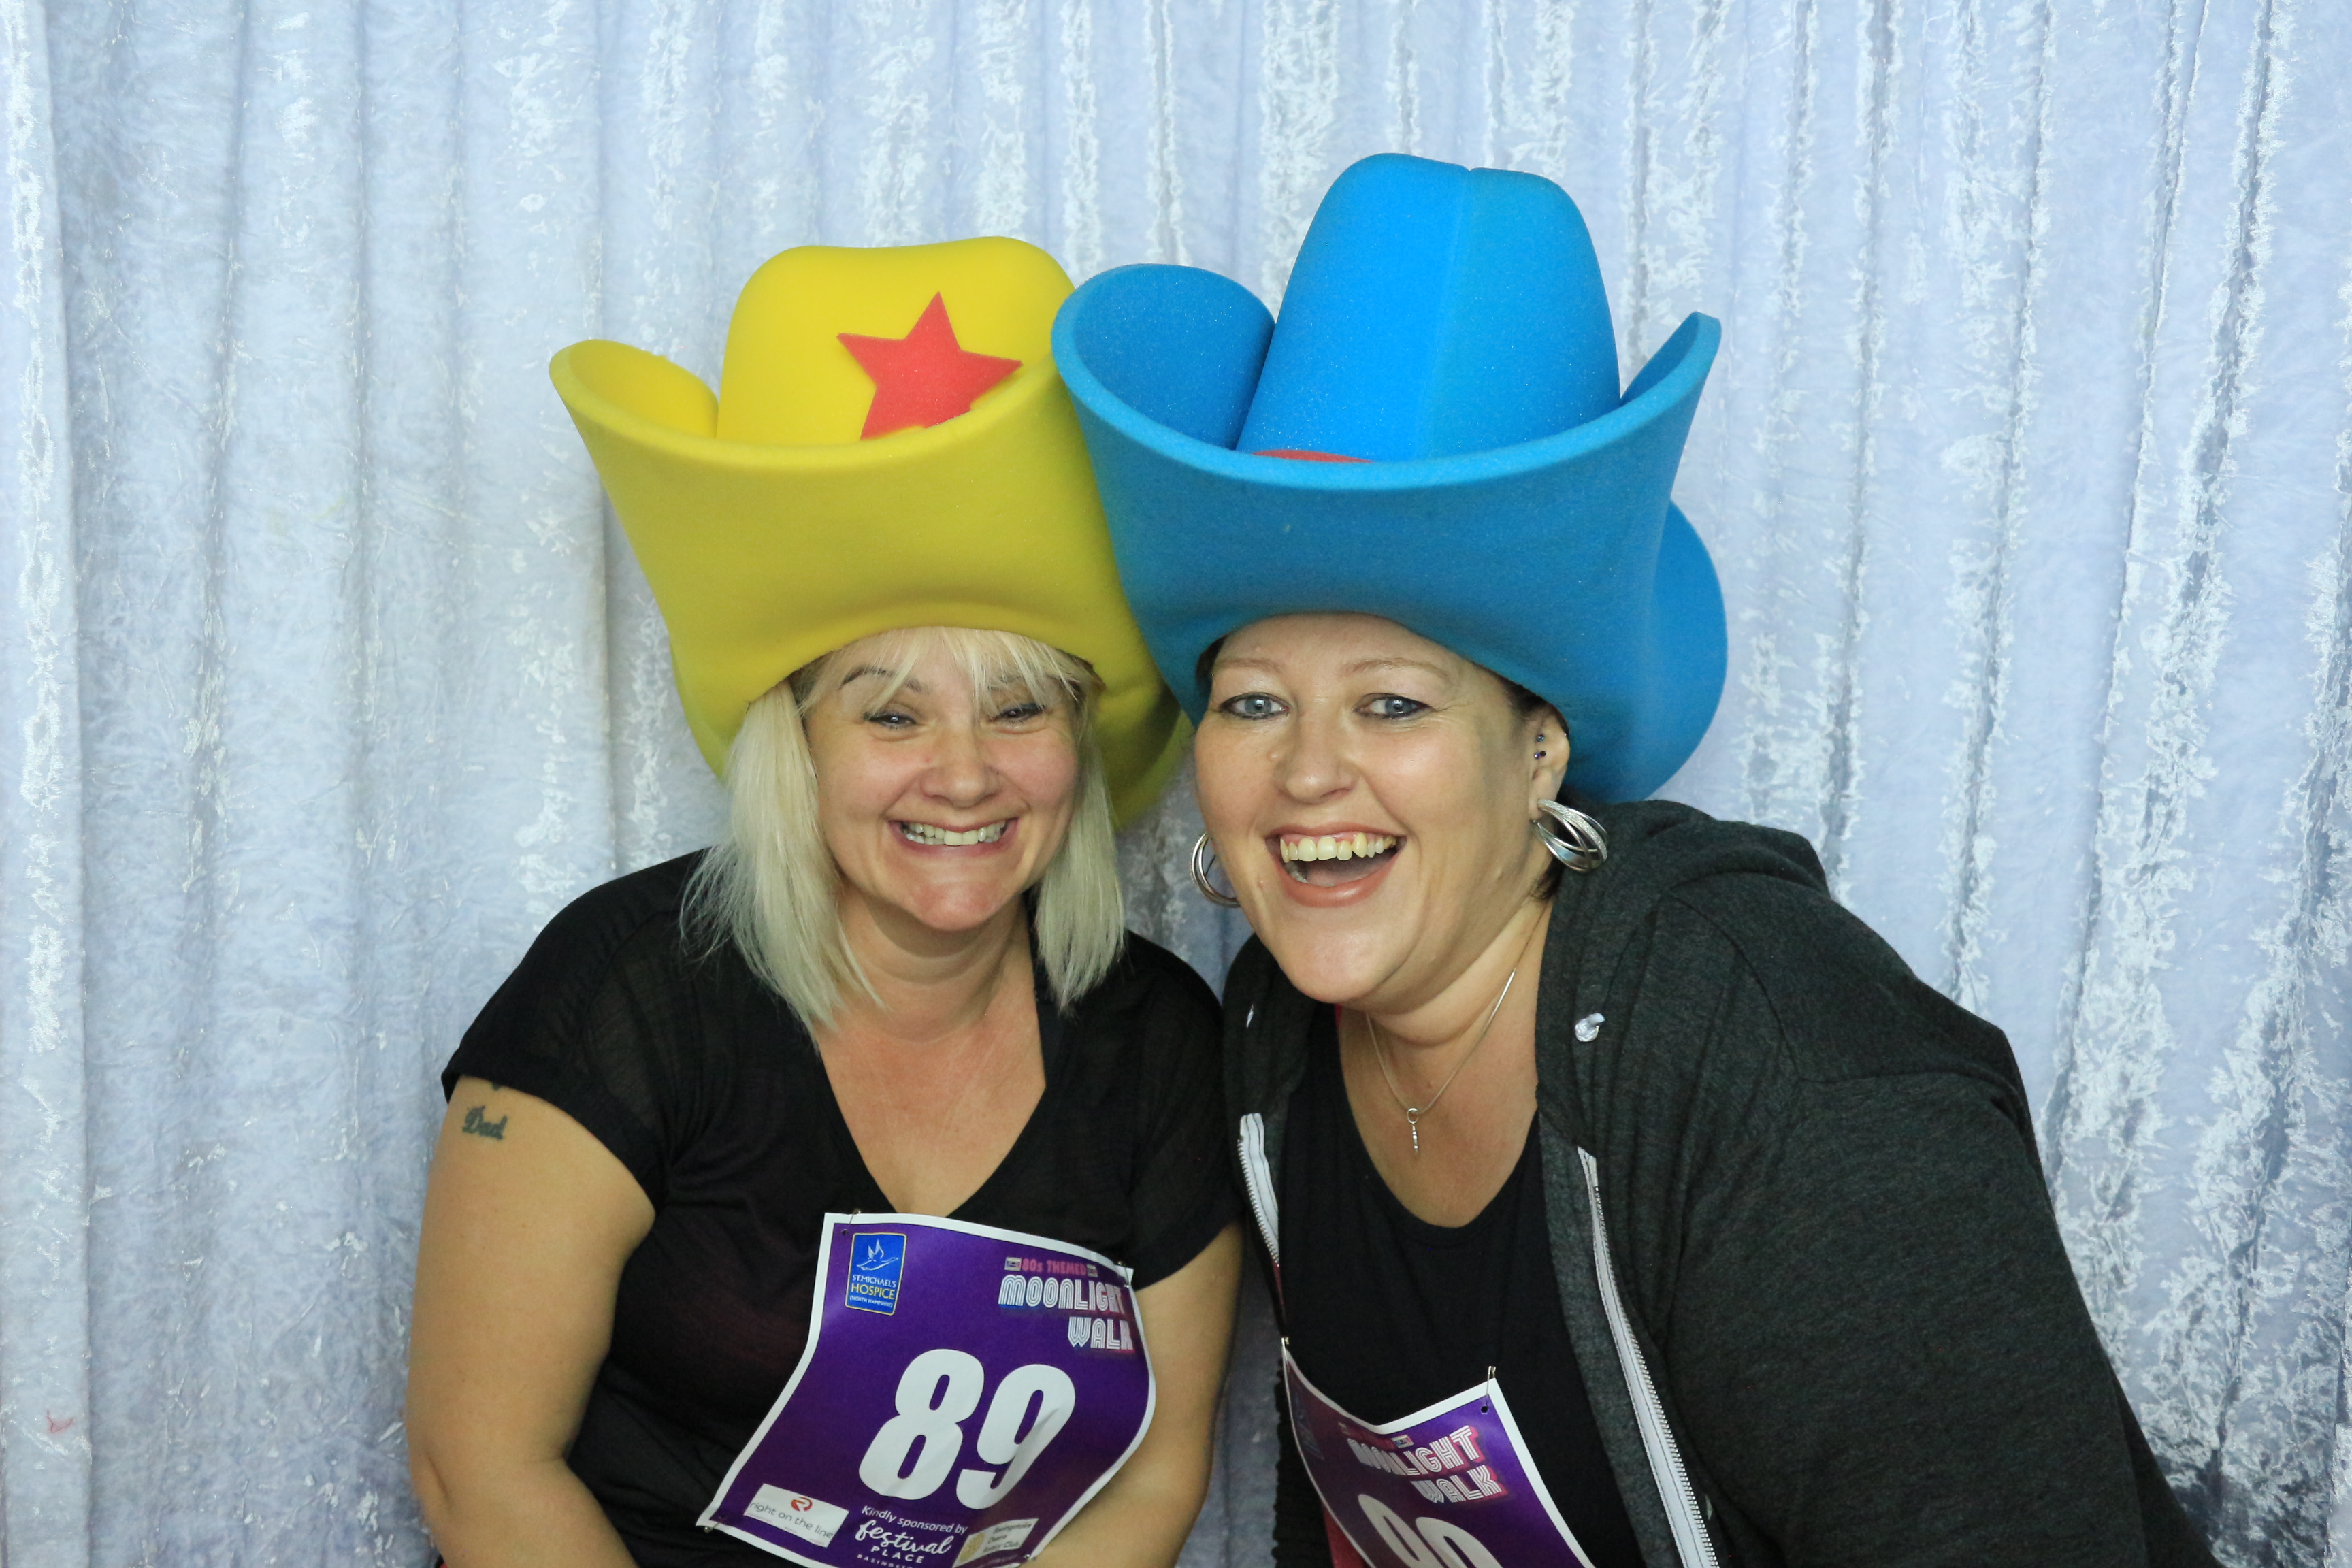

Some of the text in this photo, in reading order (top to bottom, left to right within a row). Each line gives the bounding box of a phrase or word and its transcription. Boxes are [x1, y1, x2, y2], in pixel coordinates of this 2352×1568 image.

[1022, 1258, 1087, 1275] 80s THEMED
[851, 1282, 896, 1300] HOSPICE
[998, 1274, 1125, 1314] MOONLIGHT
[1067, 1316, 1134, 1350] WALK
[858, 1348, 1076, 1510] 89
[1410, 1464, 1503, 1504] WALK
[749, 1502, 777, 1516] right
[778, 1512, 793, 1522] on
[794, 1516, 813, 1531] the
[815, 1525, 834, 1539] line
[855, 1520, 955, 1554] festival
[862, 1505, 968, 1535] Kindly sponsored by
[870, 1546, 925, 1563] PLACE
